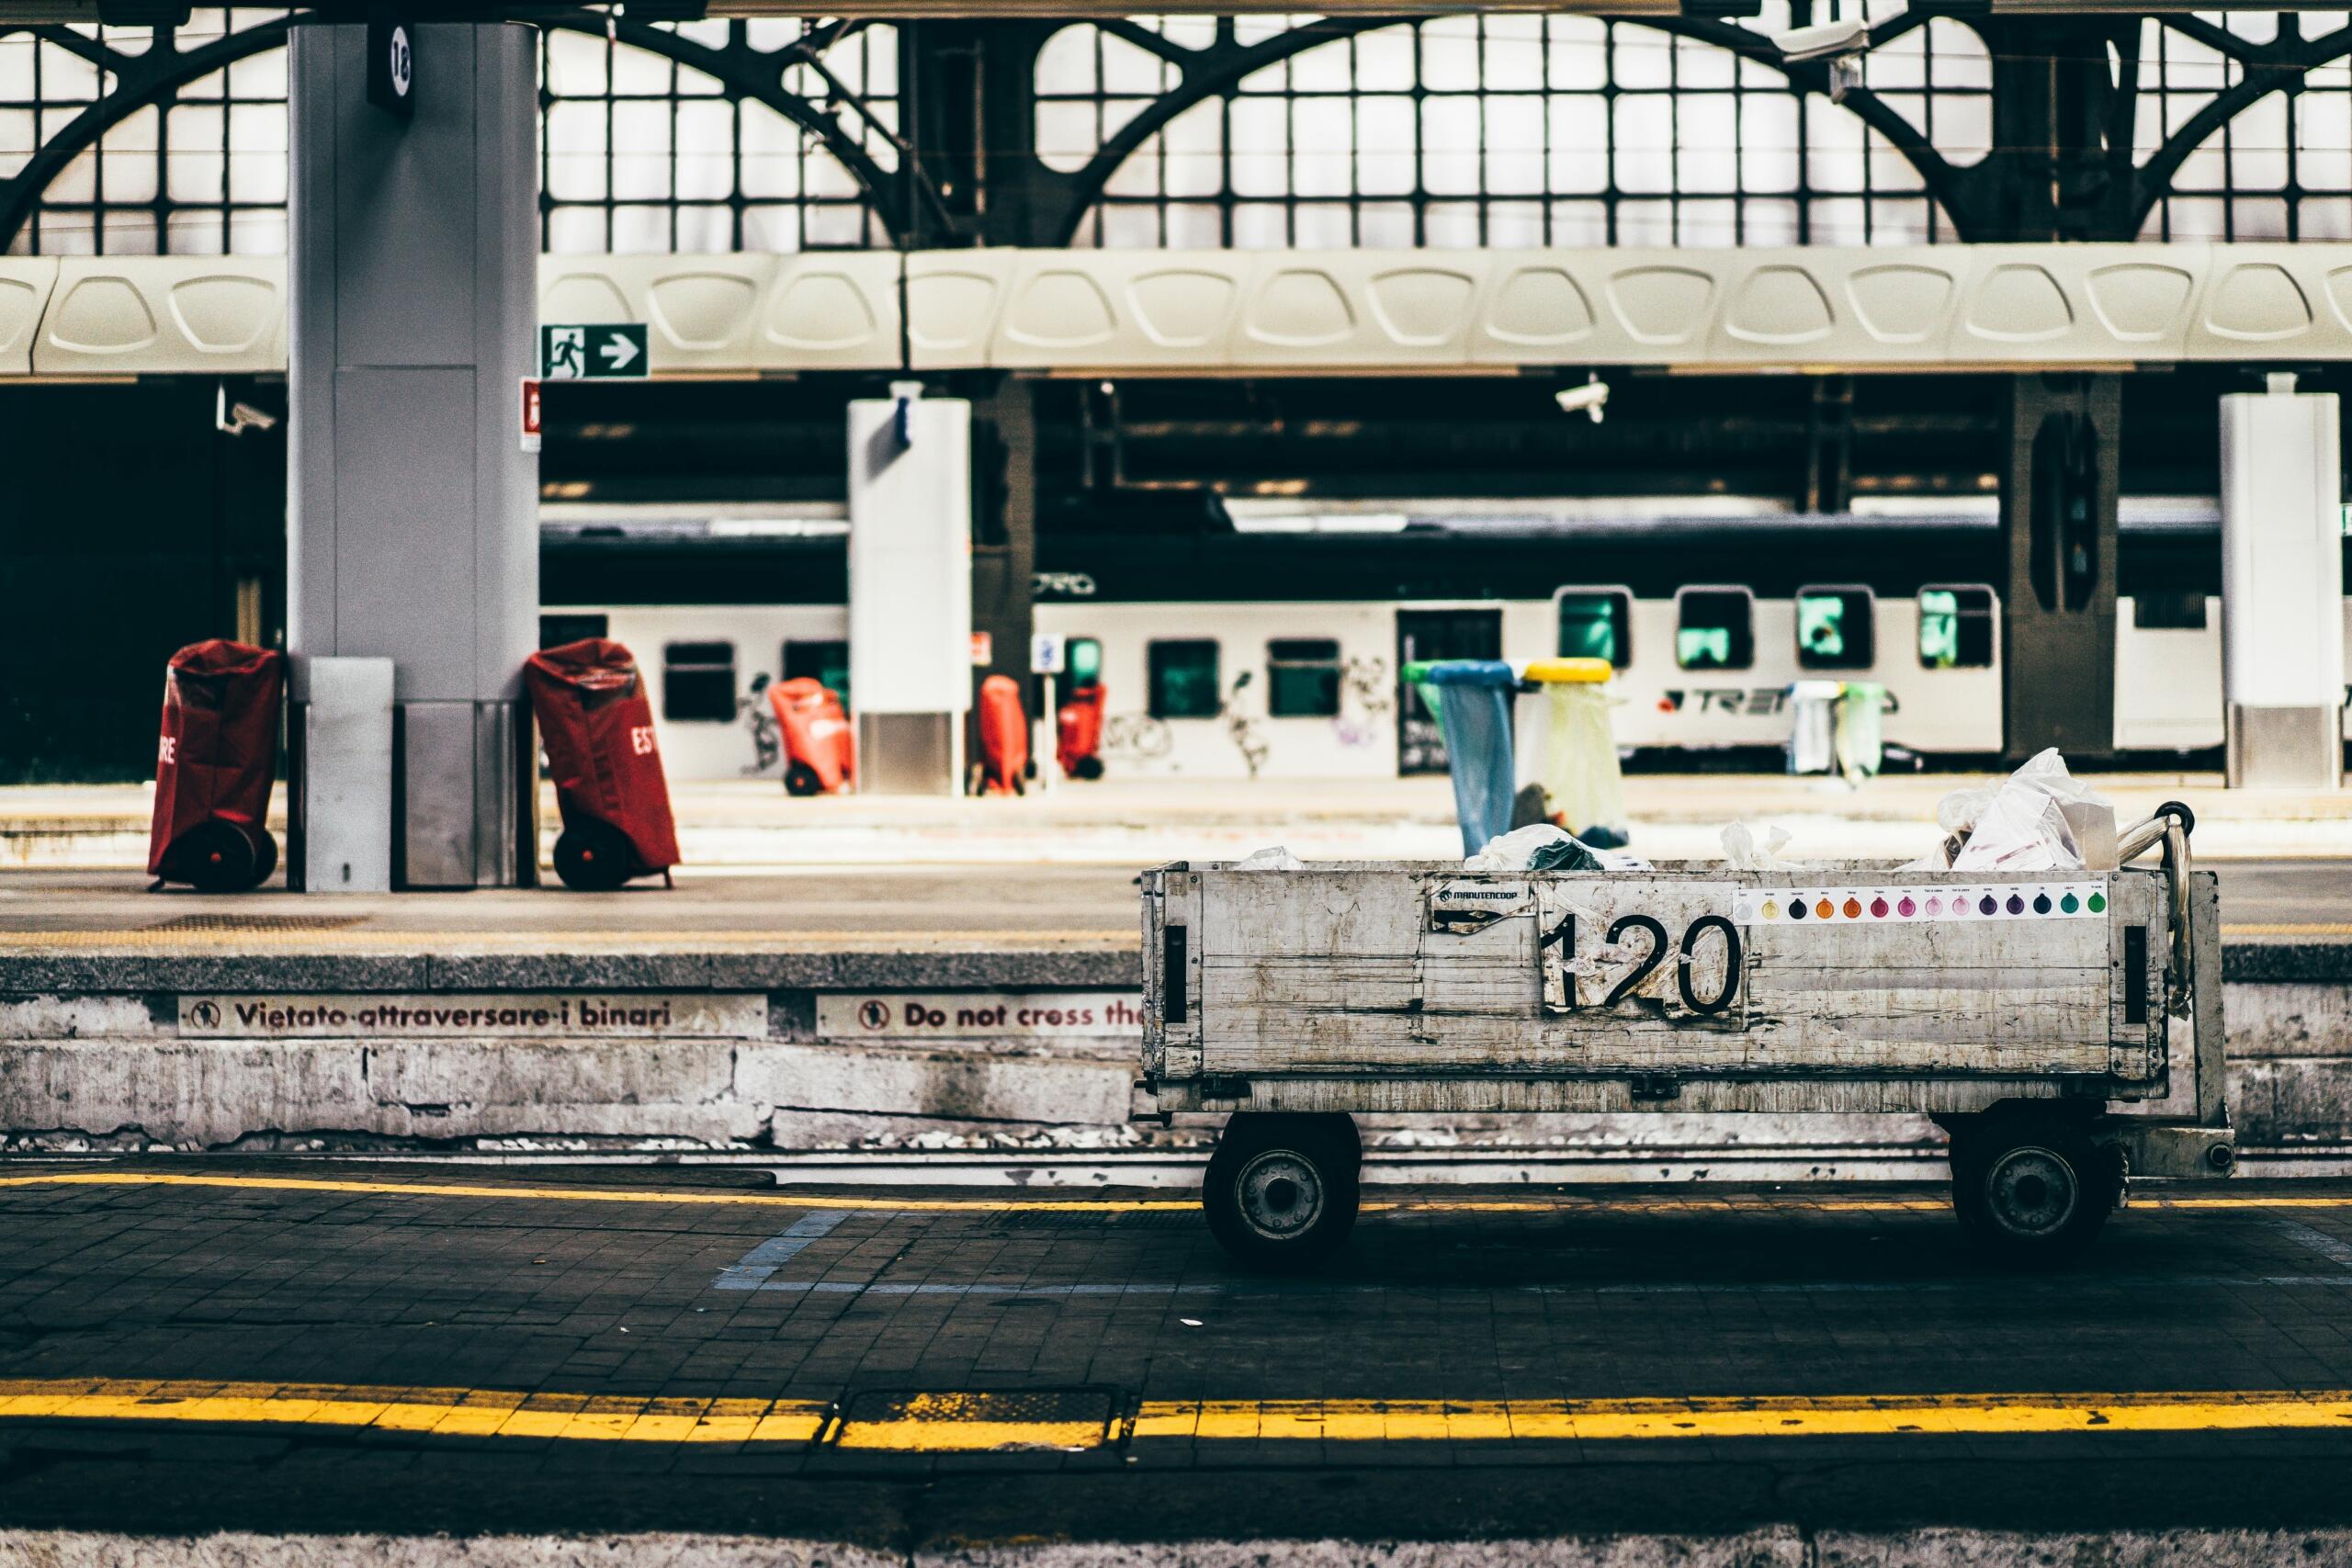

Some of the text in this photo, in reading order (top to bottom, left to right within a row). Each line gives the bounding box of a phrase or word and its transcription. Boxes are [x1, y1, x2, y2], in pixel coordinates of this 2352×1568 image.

[392, 40, 410, 83] 18
[1453, 890, 1518, 900] MANUTENCOOP
[1540, 913, 1743, 1015] 120
[235, 999, 672, 1028] Vietato attraversare i binari
[904, 1002, 947, 1027] Do
[956, 1005, 1008, 1027] not
[1016, 1009, 1094, 1027] cross
